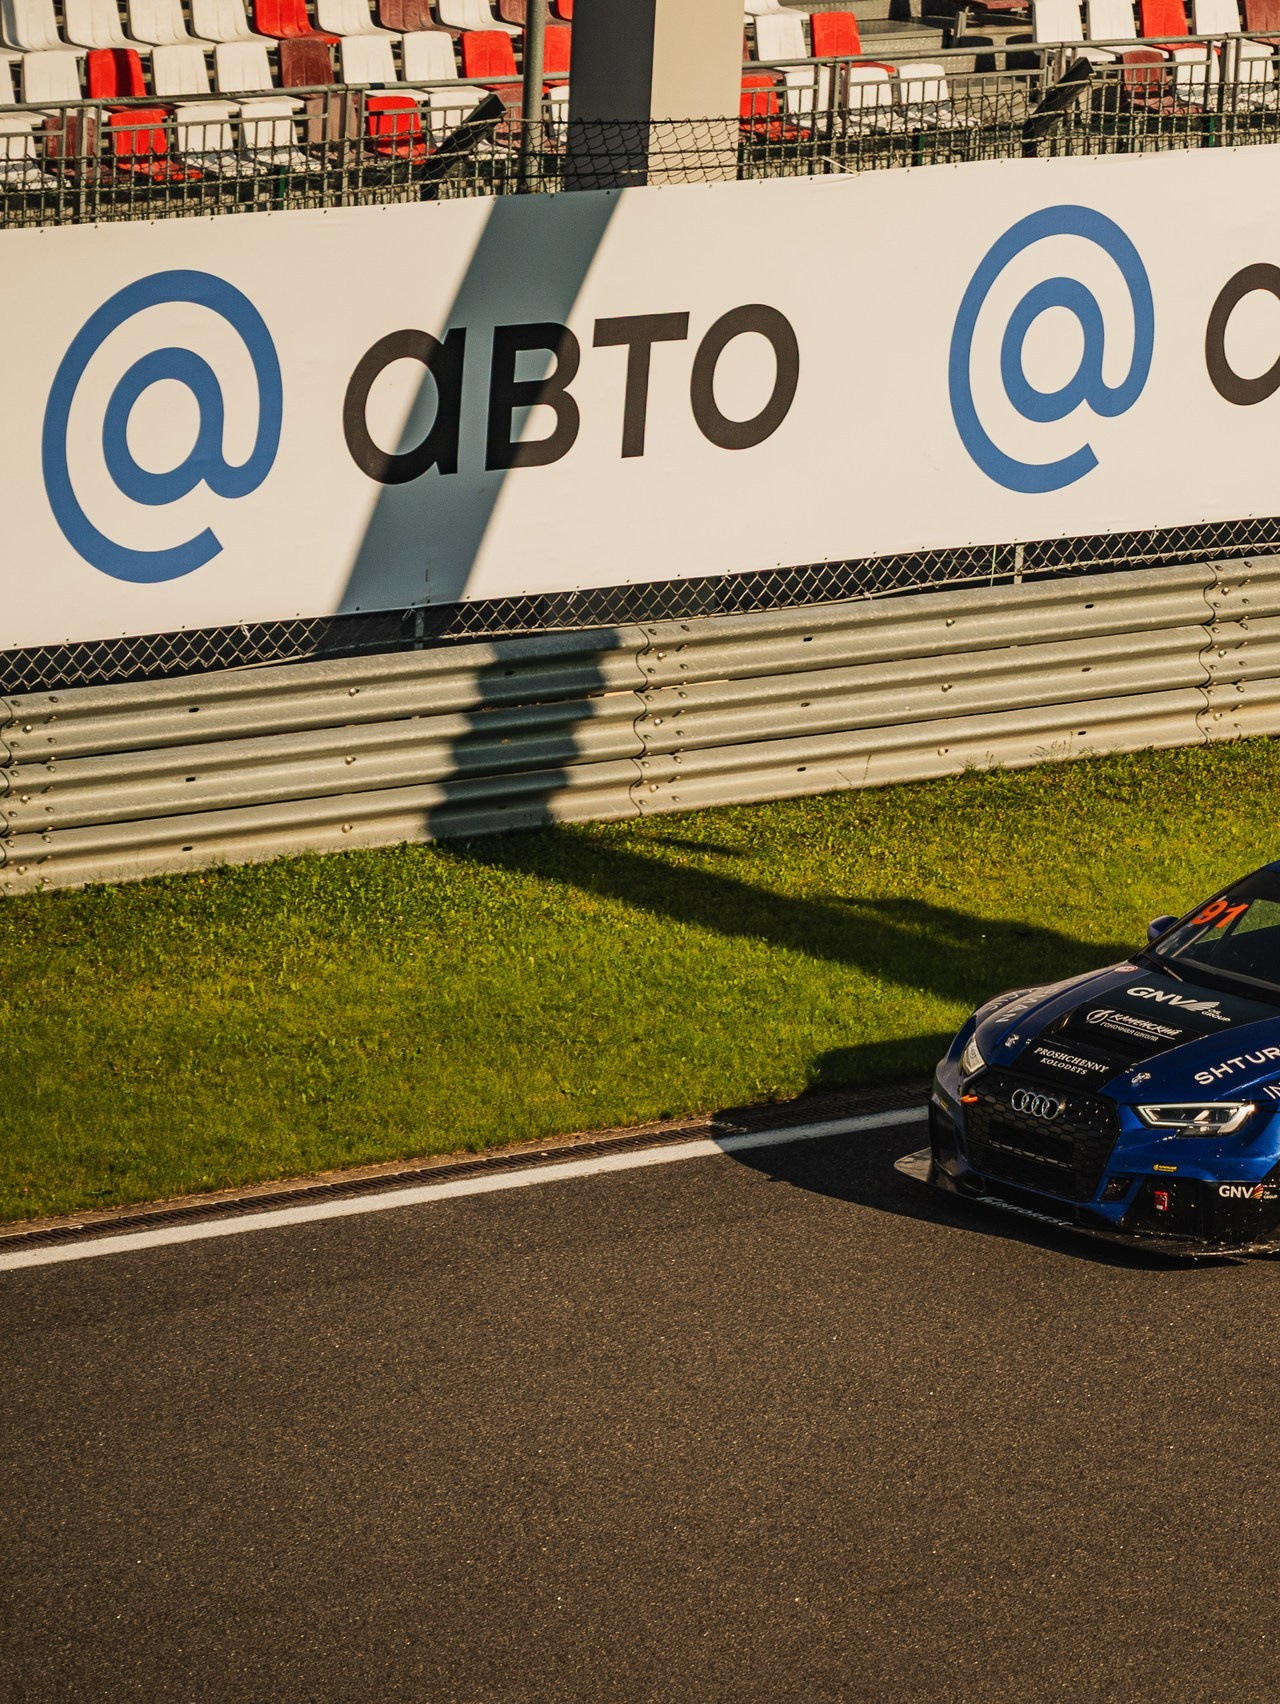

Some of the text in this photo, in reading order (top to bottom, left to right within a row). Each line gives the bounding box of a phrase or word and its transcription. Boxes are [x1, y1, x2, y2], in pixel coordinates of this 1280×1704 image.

[1191, 899, 1248, 928] 91
[1126, 987, 1198, 1006] GNV
[1109, 1012, 1183, 1037] КАМЕНСКИЙ
[1034, 1047, 1110, 1073] PROSHCHENNY
[1040, 1057, 1088, 1075] KOLODETS
[1218, 1185, 1254, 1199] GNV
